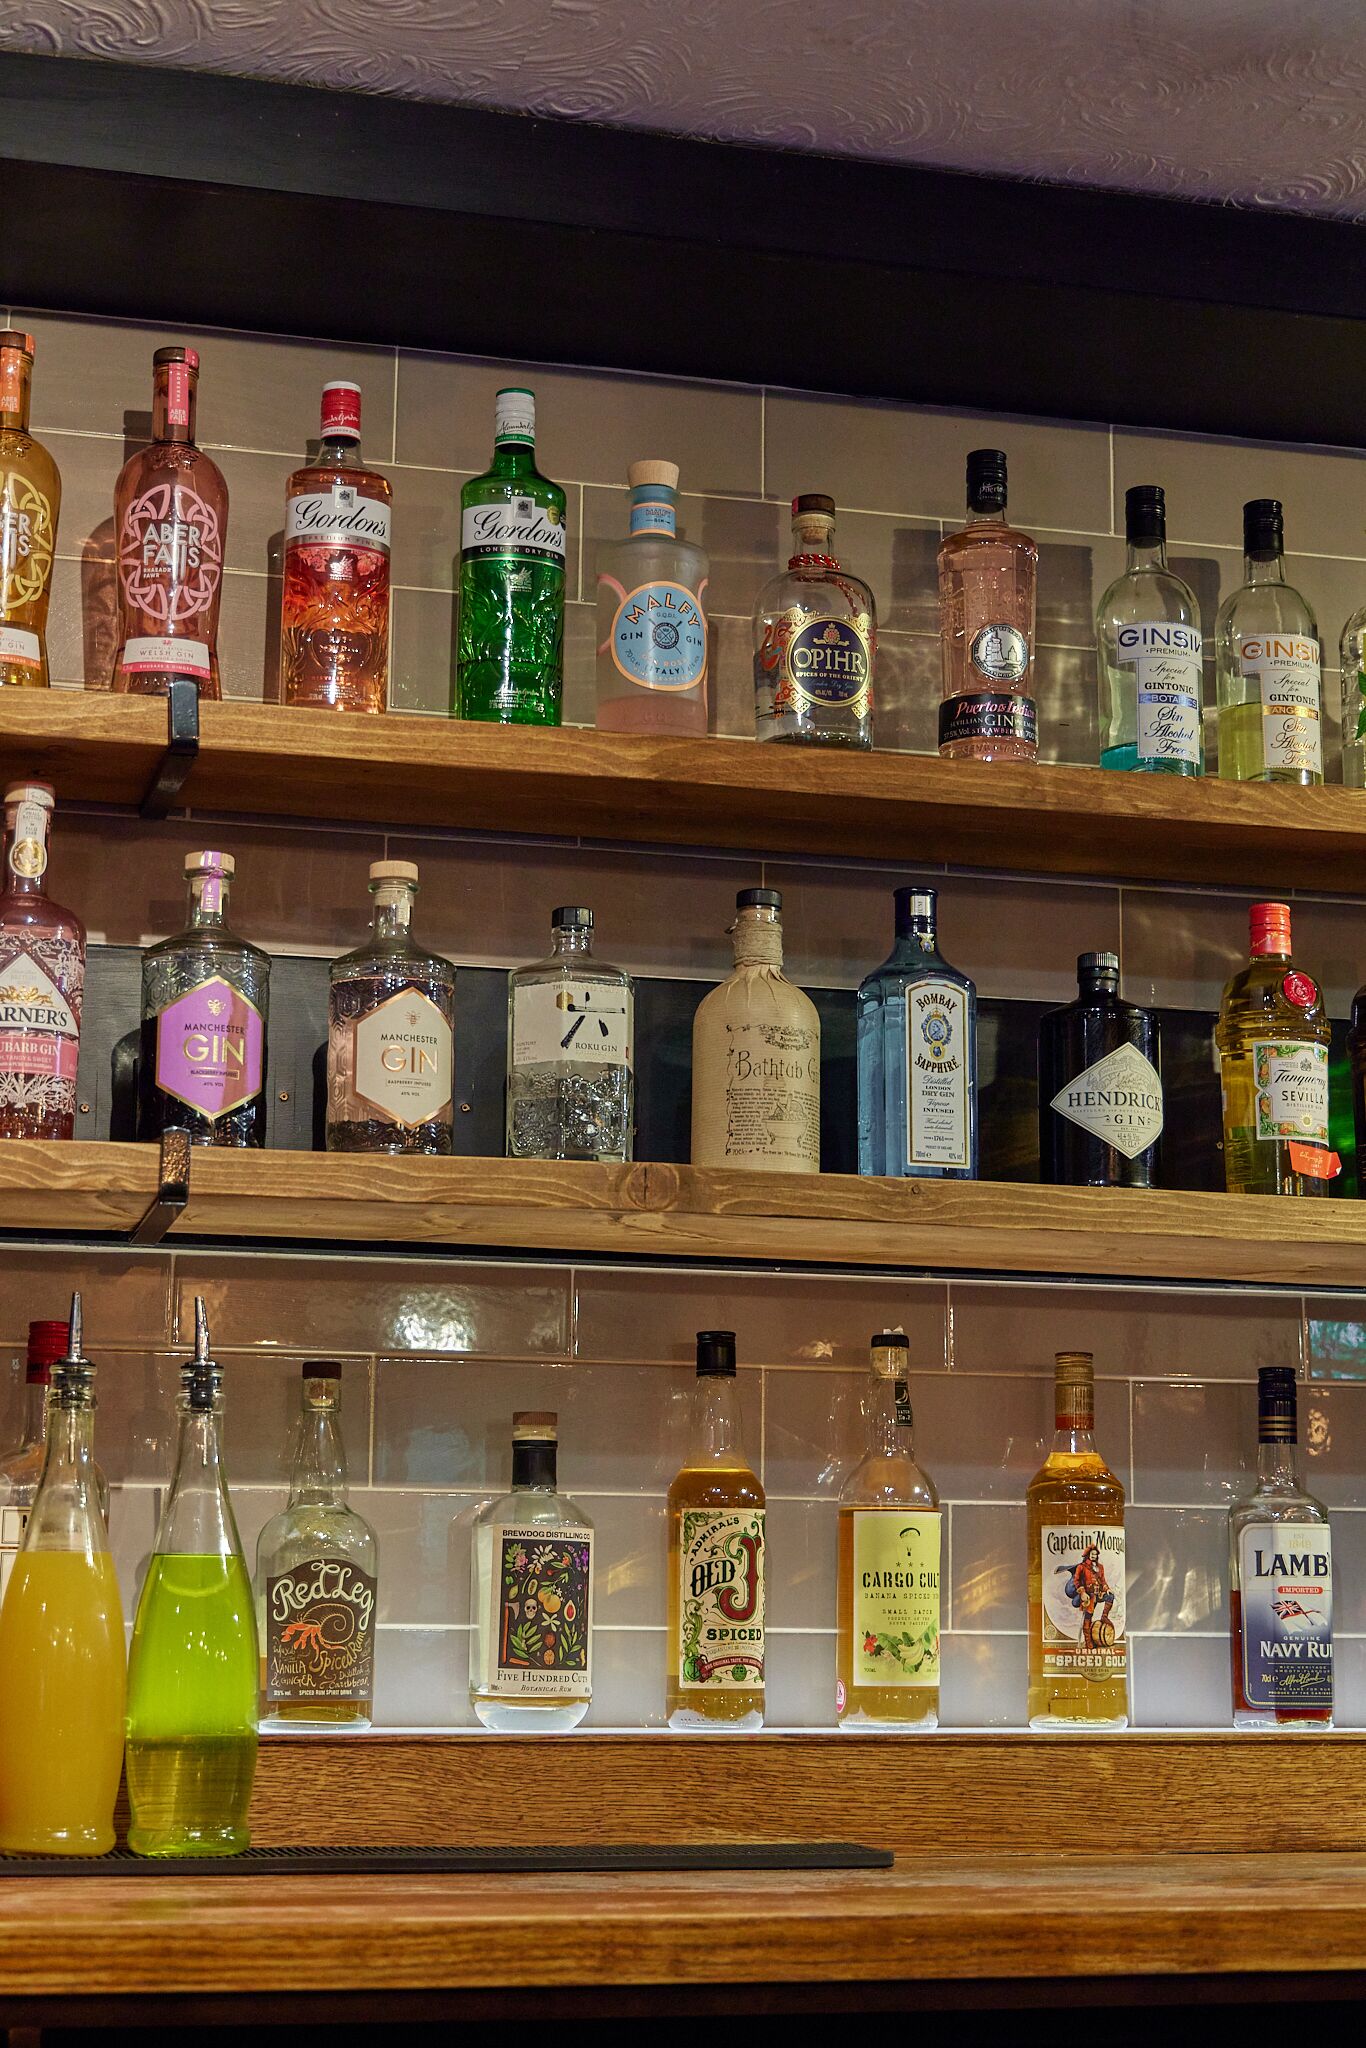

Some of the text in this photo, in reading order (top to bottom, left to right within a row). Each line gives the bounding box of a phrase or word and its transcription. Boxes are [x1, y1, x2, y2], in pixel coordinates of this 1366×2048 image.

[295, 499, 387, 540] Gordon's
[142, 522, 202, 548] ABER
[473, 510, 563, 549] Gordon's
[545, 552, 559, 560] GIN
[625, 593, 701, 629] MALFY
[8, 640, 25, 650] GIN
[620, 631, 703, 647] GIN GIN
[176, 651, 195, 660] GIN
[1150, 647, 1188, 657] PREMIUM
[793, 647, 866, 675] OPIHR
[1149, 660, 1187, 677] Special
[1273, 659, 1310, 669] PREMIUM
[1163, 673, 1176, 681] for
[1273, 673, 1311, 688] Special
[1144, 682, 1194, 694] GINTONIC
[1269, 693, 1316, 706] GINTONIC
[955, 700, 997, 720] Puerto
[1157, 706, 1183, 722] Sin
[984, 713, 1015, 727] GIN
[1282, 718, 1307, 734] Sin
[1144, 720, 1194, 740] Alcohol
[1155, 738, 1186, 755] Free
[1270, 732, 1317, 753] Alcohol
[915, 992, 958, 1013] BOMBAY
[0, 1006, 67, 1027] RNER'S
[184, 1022, 245, 1035] MANCHESTER
[380, 1033, 438, 1045] MANCHESTER
[0, 1041, 59, 1056] UBARB GIN
[183, 1033, 245, 1066] GIN
[575, 1042, 618, 1053] ROKU GIN
[380, 1044, 438, 1075] GIN
[735, 1050, 803, 1081] Bathtub
[914, 1053, 961, 1074] SAPPHIRE
[939, 1090, 955, 1098] GIN
[1067, 1091, 1161, 1112] HENDRICK
[1281, 1090, 1324, 1104] SEVILLA
[1114, 1114, 1145, 1126] GIN
[502, 1529, 545, 1538] BREWDOG
[546, 1531, 583, 1540] DISTILLING
[690, 1516, 740, 1557] ADMIRAL'S
[1046, 1530, 1125, 1555] Captain Morga
[1254, 1549, 1331, 1577] LAMB'
[690, 1559, 736, 1598] OLD
[862, 1571, 914, 1589] CARGO
[272, 1559, 375, 1631] Red Leg
[864, 1592, 897, 1600] BANANA
[1282, 1586, 1320, 1594] IMPORTED
[706, 1628, 762, 1641] SPICED
[1260, 1640, 1304, 1658] NAVY
[1055, 1655, 1103, 1667] SPICED
